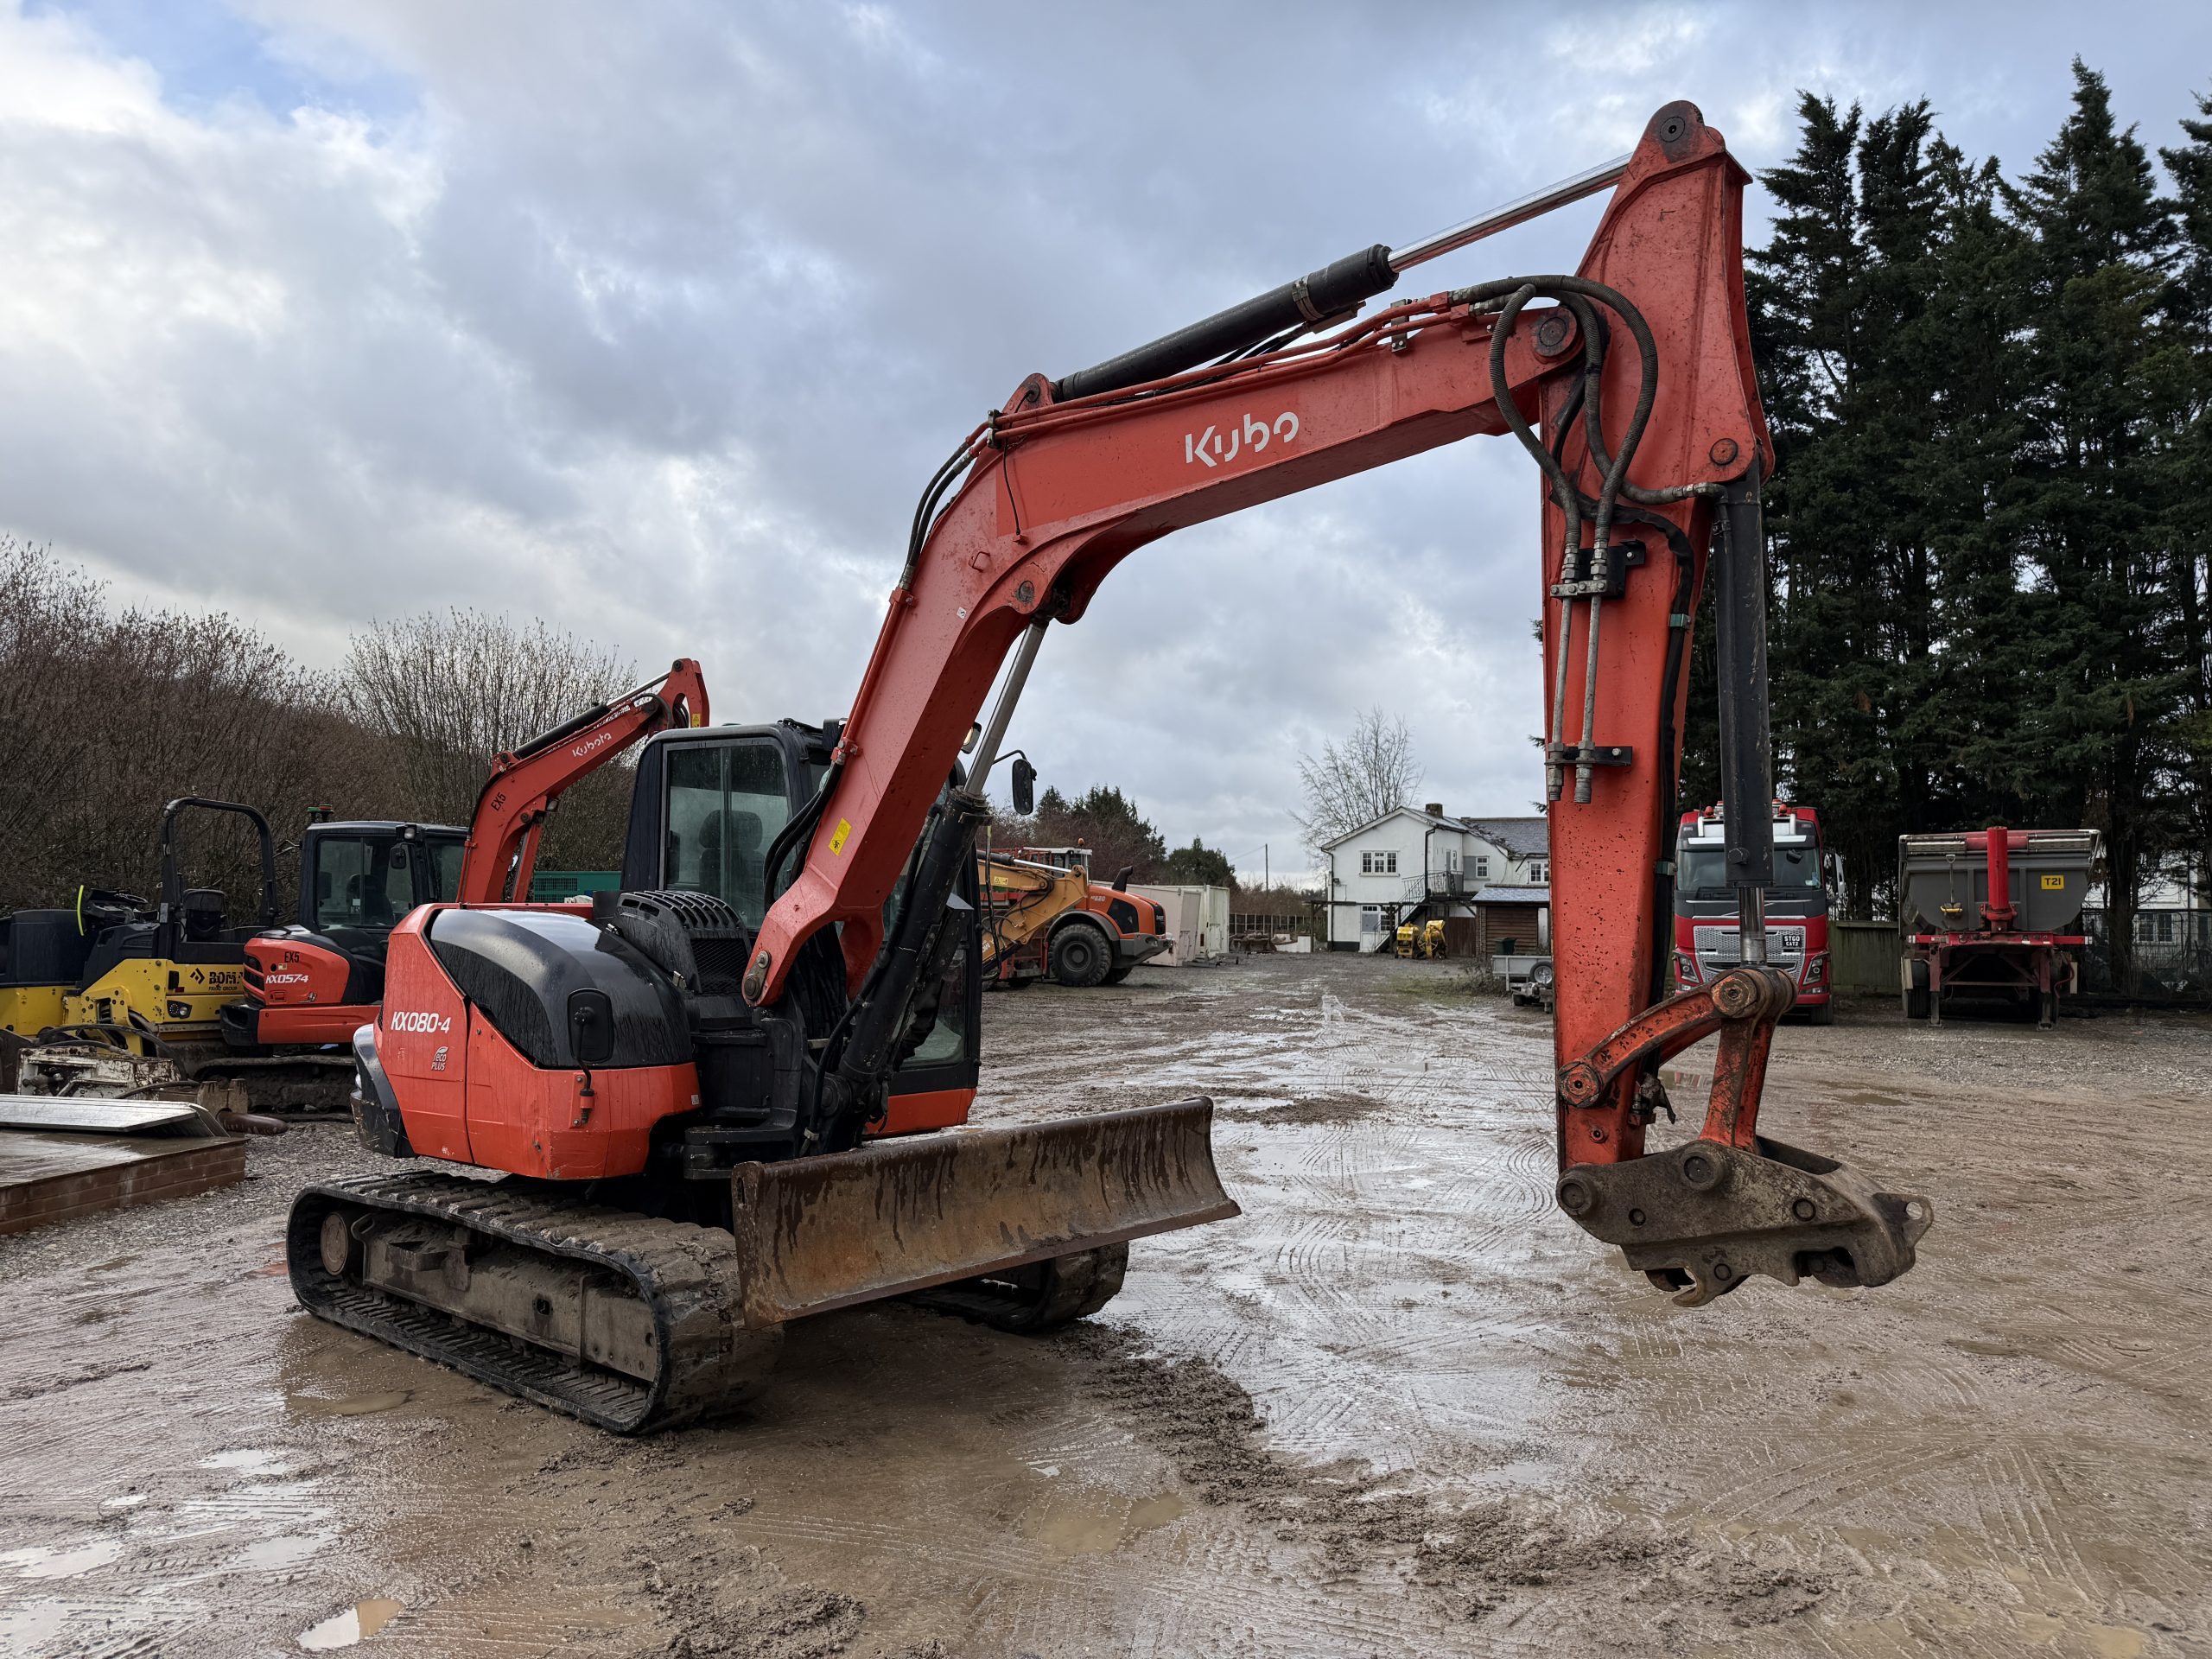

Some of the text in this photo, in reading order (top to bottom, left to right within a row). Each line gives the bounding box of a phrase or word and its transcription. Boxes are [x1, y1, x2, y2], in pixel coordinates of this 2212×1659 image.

[1185, 411, 1300, 467] Kubo
[572, 733, 612, 757] Kubota
[491, 792, 506, 811] EX5
[284, 951, 300, 963] EX5
[391, 1011, 451, 1034] KX080-4
[431, 1062, 446, 1071] PLUS
[435, 1053, 447, 1062] eco
